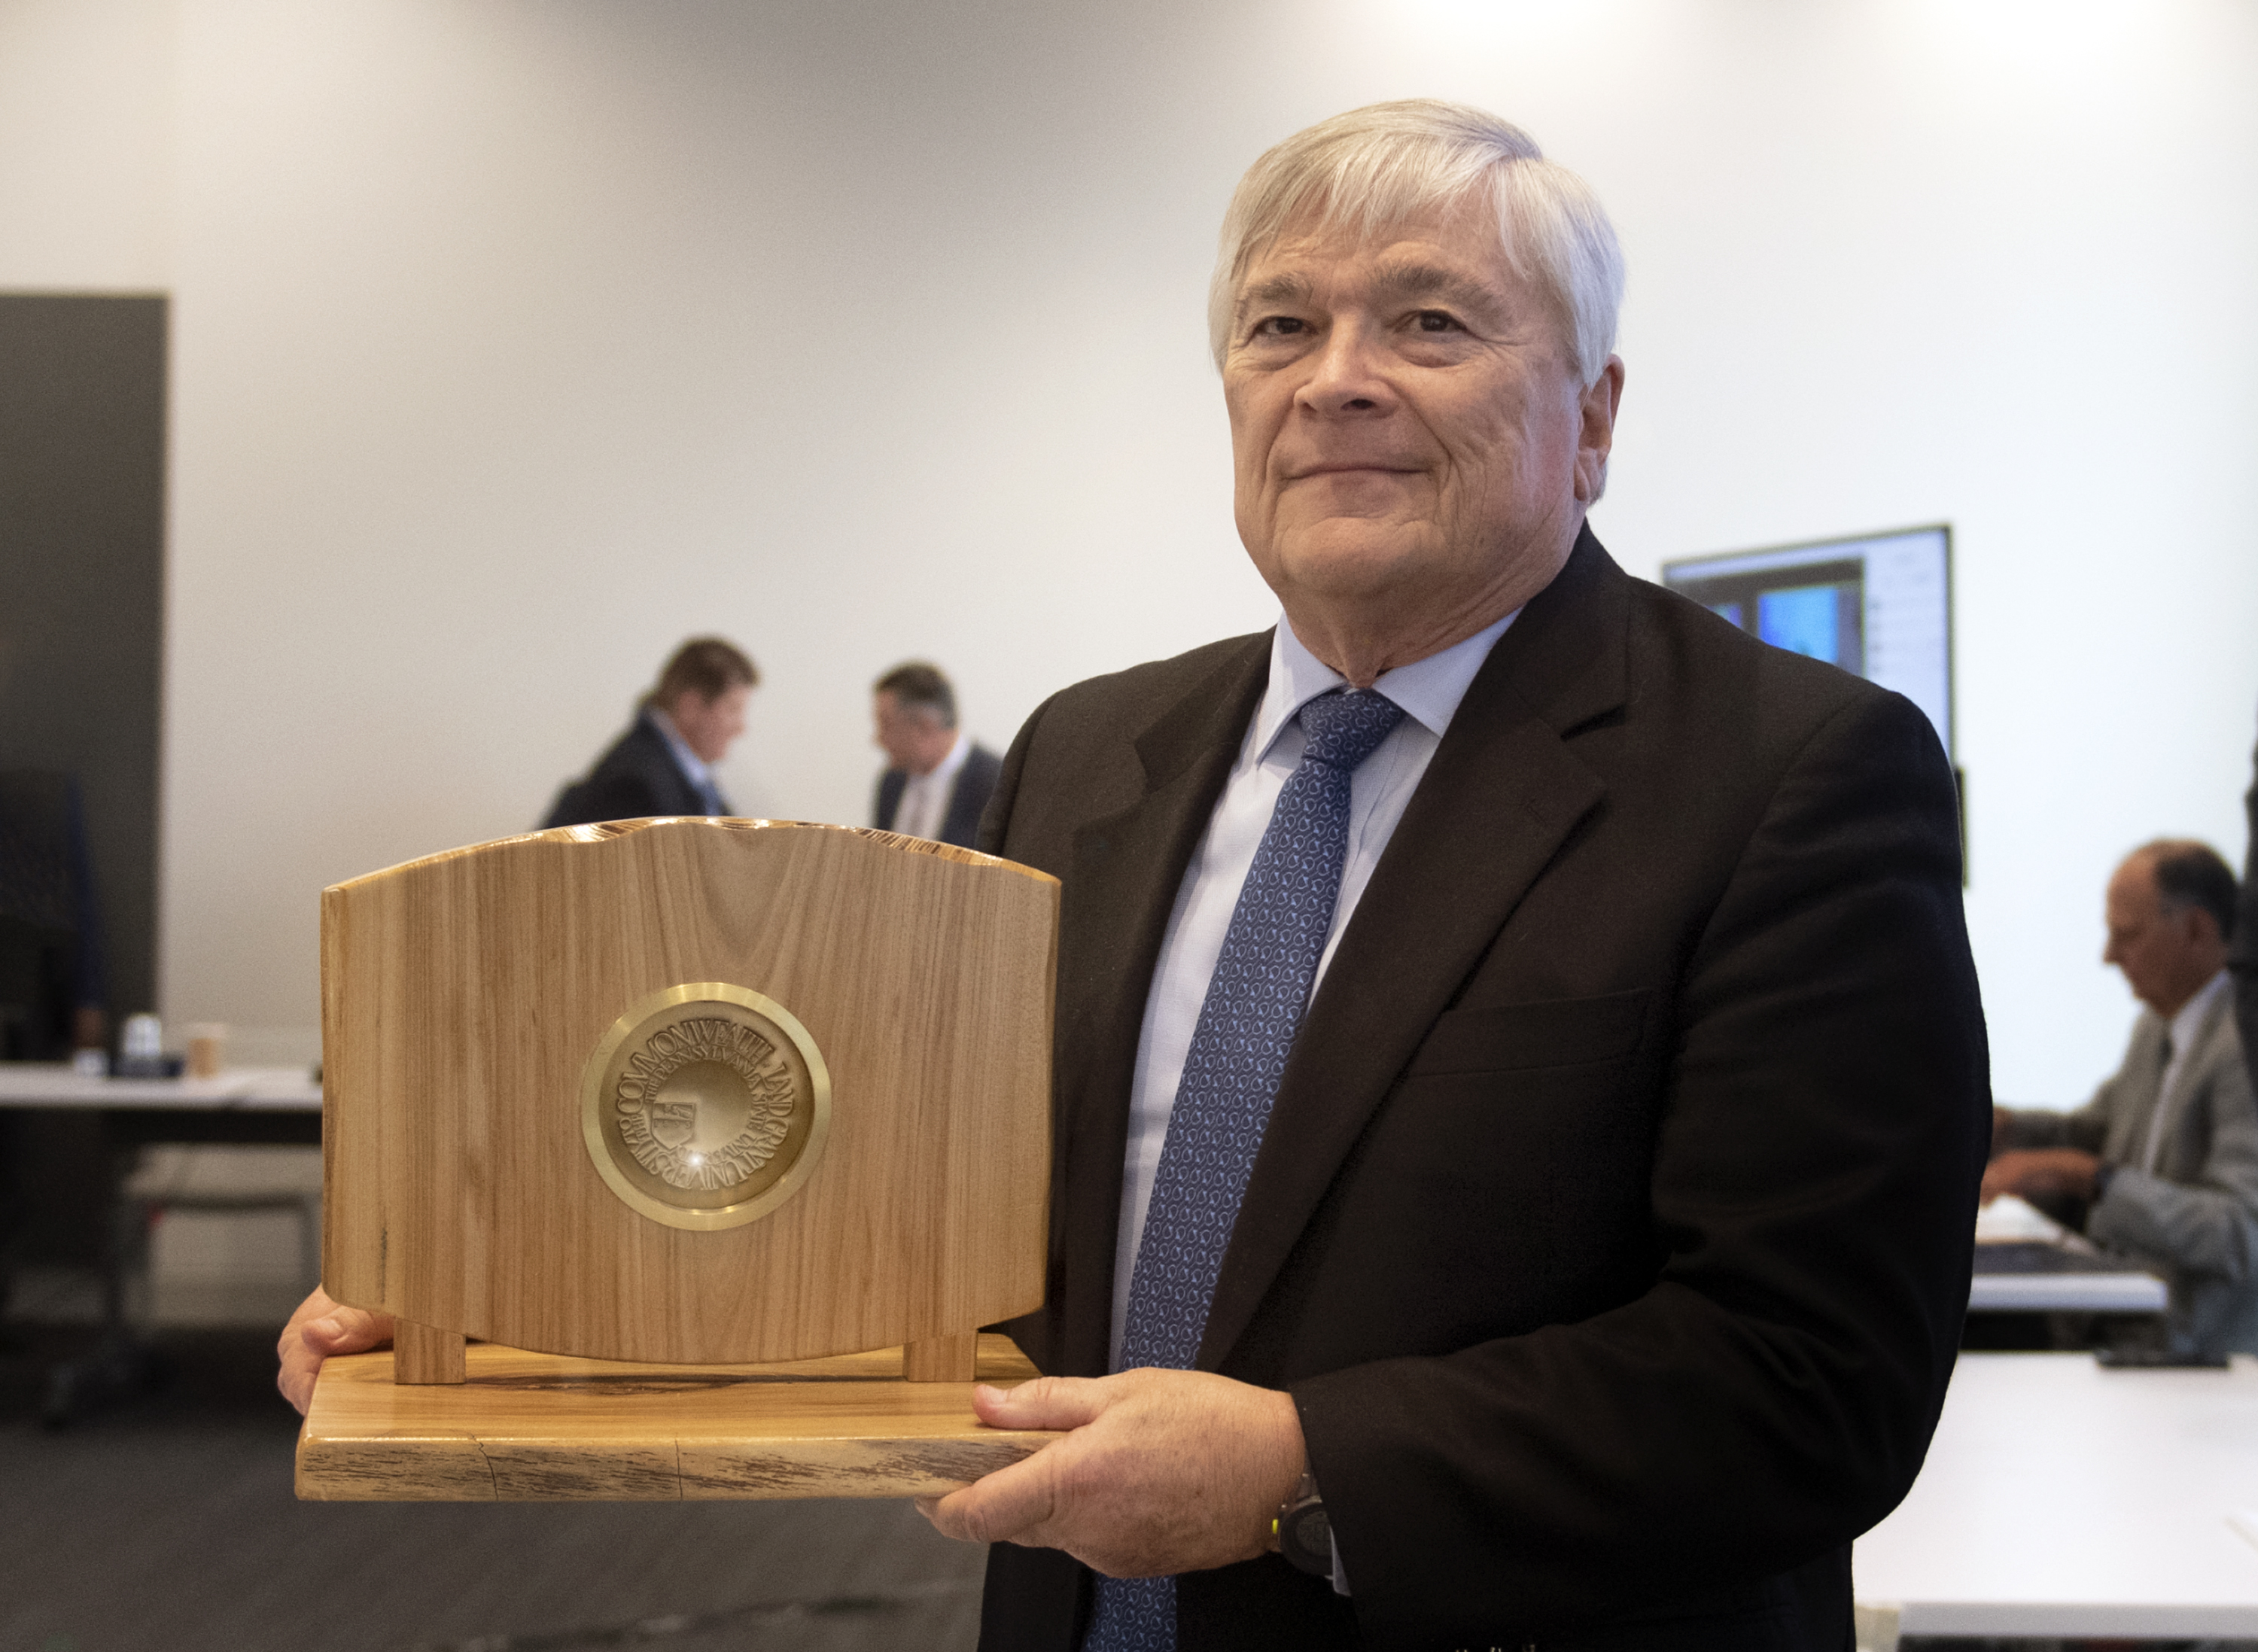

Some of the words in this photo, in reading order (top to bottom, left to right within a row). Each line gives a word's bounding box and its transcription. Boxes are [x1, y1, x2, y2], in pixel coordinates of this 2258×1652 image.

[618, 1021, 774, 1113] COMMONWEALTH
[644, 1079, 661, 1102] THE
[653, 1045, 762, 1089] PENNSYLVANIA
[762, 1062, 793, 1116] LAND
[747, 1092, 768, 1129] STATE
[630, 1139, 750, 1190] UNIVERSITY
[678, 1133, 754, 1165] UNIVERTY
[747, 1117, 789, 1173] GRANT
